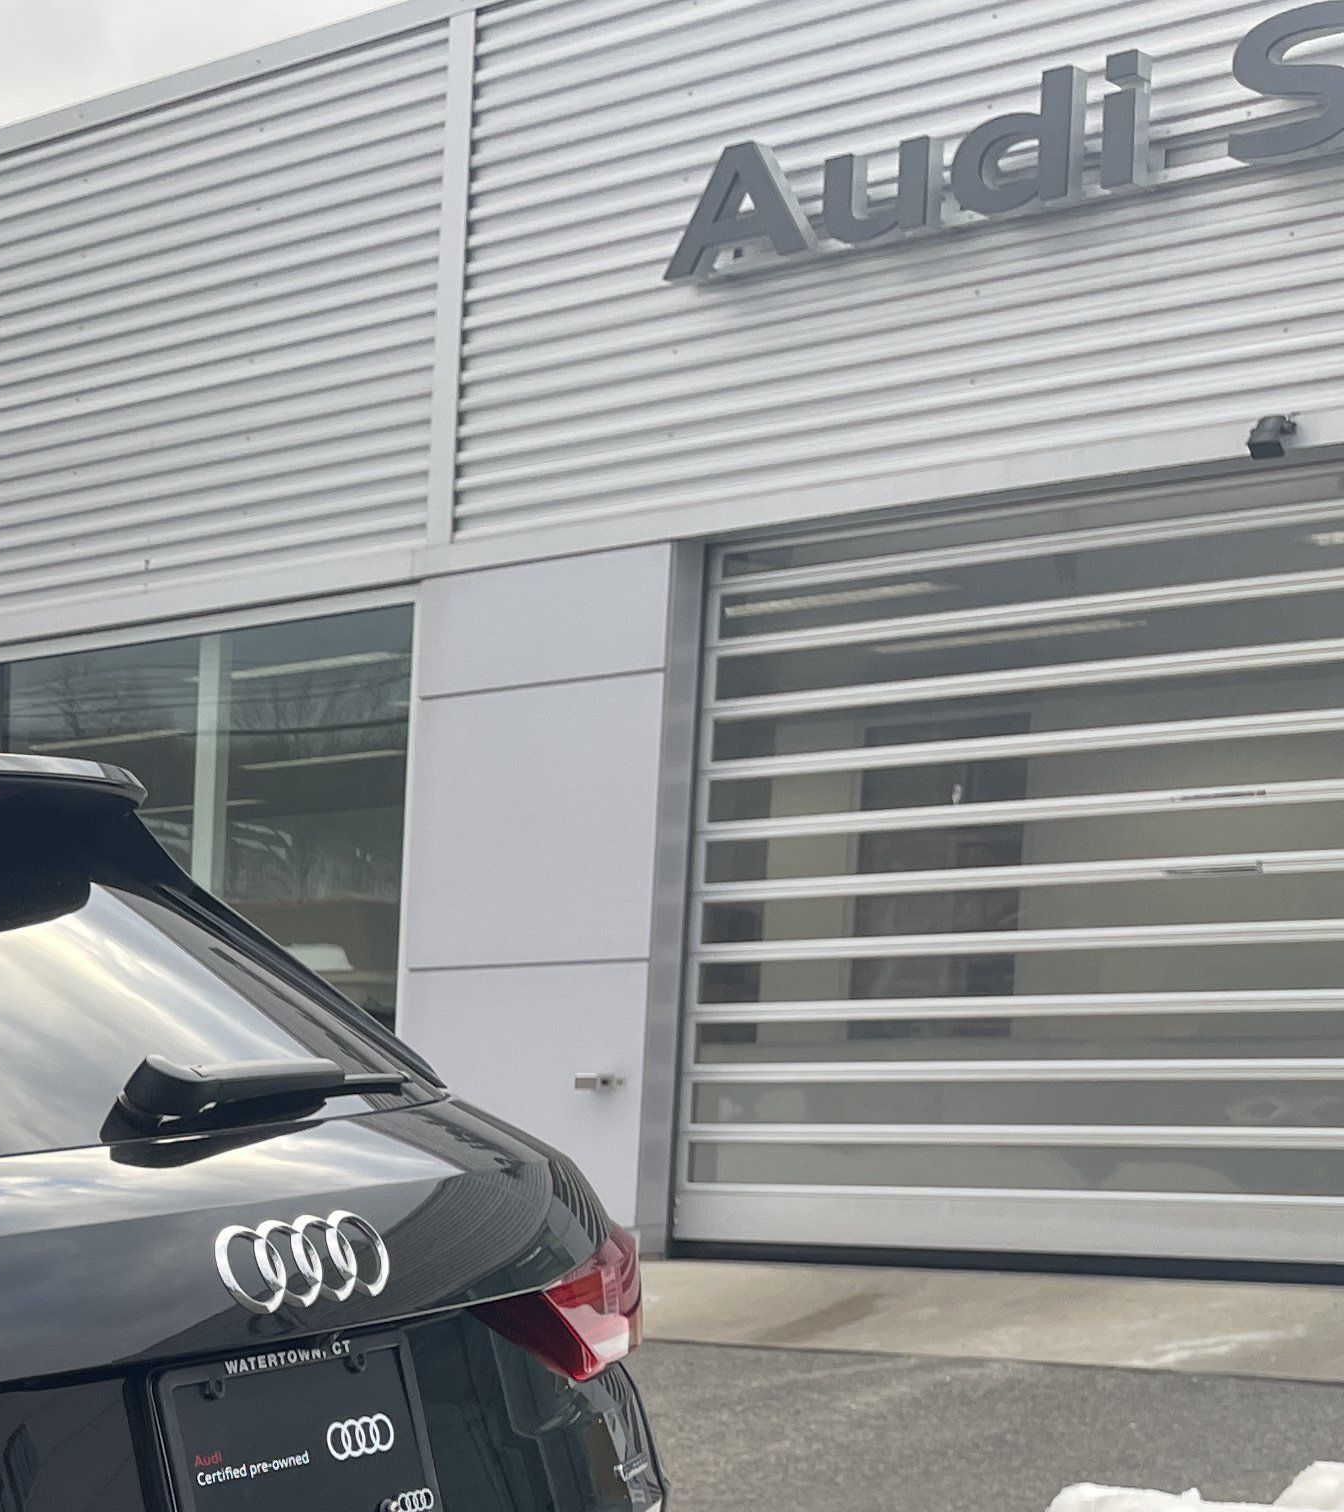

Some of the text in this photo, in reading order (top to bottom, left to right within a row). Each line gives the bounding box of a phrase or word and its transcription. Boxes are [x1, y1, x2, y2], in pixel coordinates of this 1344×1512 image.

[663, 49, 1152, 282] Audi
[224, 1340, 351, 1375] WATERTOWN, CT
[194, 1450, 223, 1467] Audi
[196, 1450, 310, 1486] Certified pre-owned
